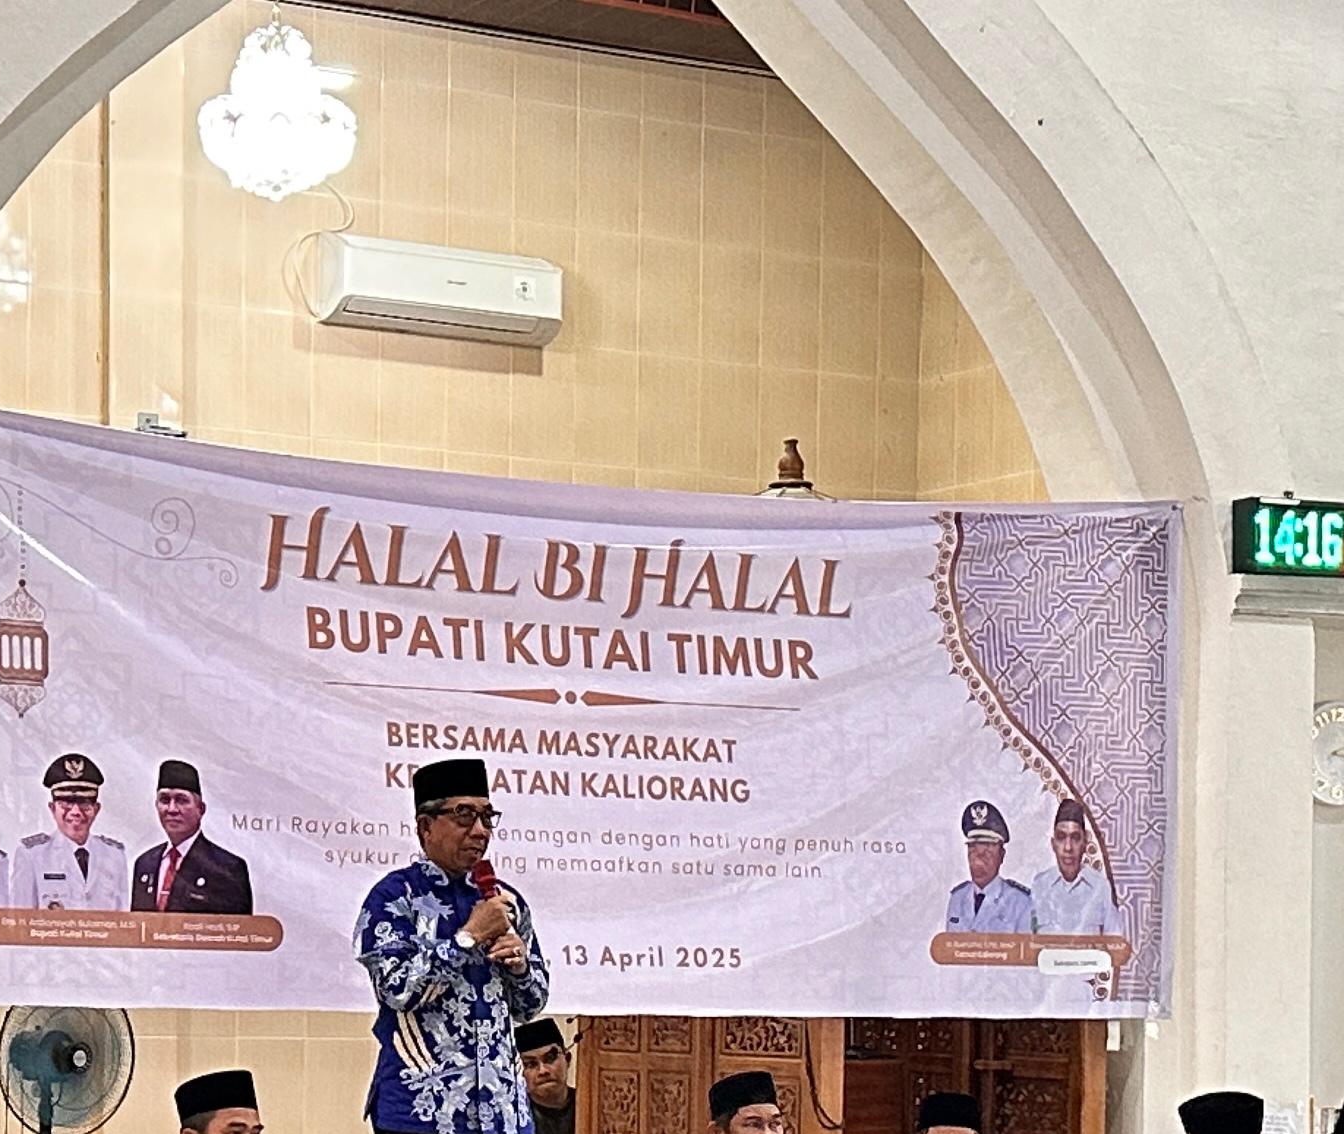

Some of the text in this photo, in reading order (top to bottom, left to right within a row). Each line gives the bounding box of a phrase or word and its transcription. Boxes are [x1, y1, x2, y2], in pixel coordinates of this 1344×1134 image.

[1253, 507, 1344, 567] 14:16
[261, 506, 852, 619] HALAL BI HALAL
[306, 606, 819, 680] BUPATI KUTAI TIMUR
[1315, 712, 1331, 727] 11
[386, 721, 737, 763] BERSAMA MASYARAKAT
[581, 772, 750, 803] KALIORANG
[1315, 778, 1330, 793] 7
[1331, 783, 1344, 800] 6
[232, 814, 281, 831] Mari
[292, 816, 389, 838] Rayakan
[601, 830, 681, 850] dengan
[689, 832, 730, 849] hati
[738, 836, 786, 855] yang
[794, 837, 854, 855] penuh
[863, 840, 907, 854] rasa
[324, 846, 401, 868] syukur
[537, 855, 662, 875] memaafkan
[671, 859, 714, 875] satu
[723, 864, 777, 877] sama
[562, 945, 588, 966] 13
[600, 945, 664, 972] April
[676, 947, 742, 968] 2025
